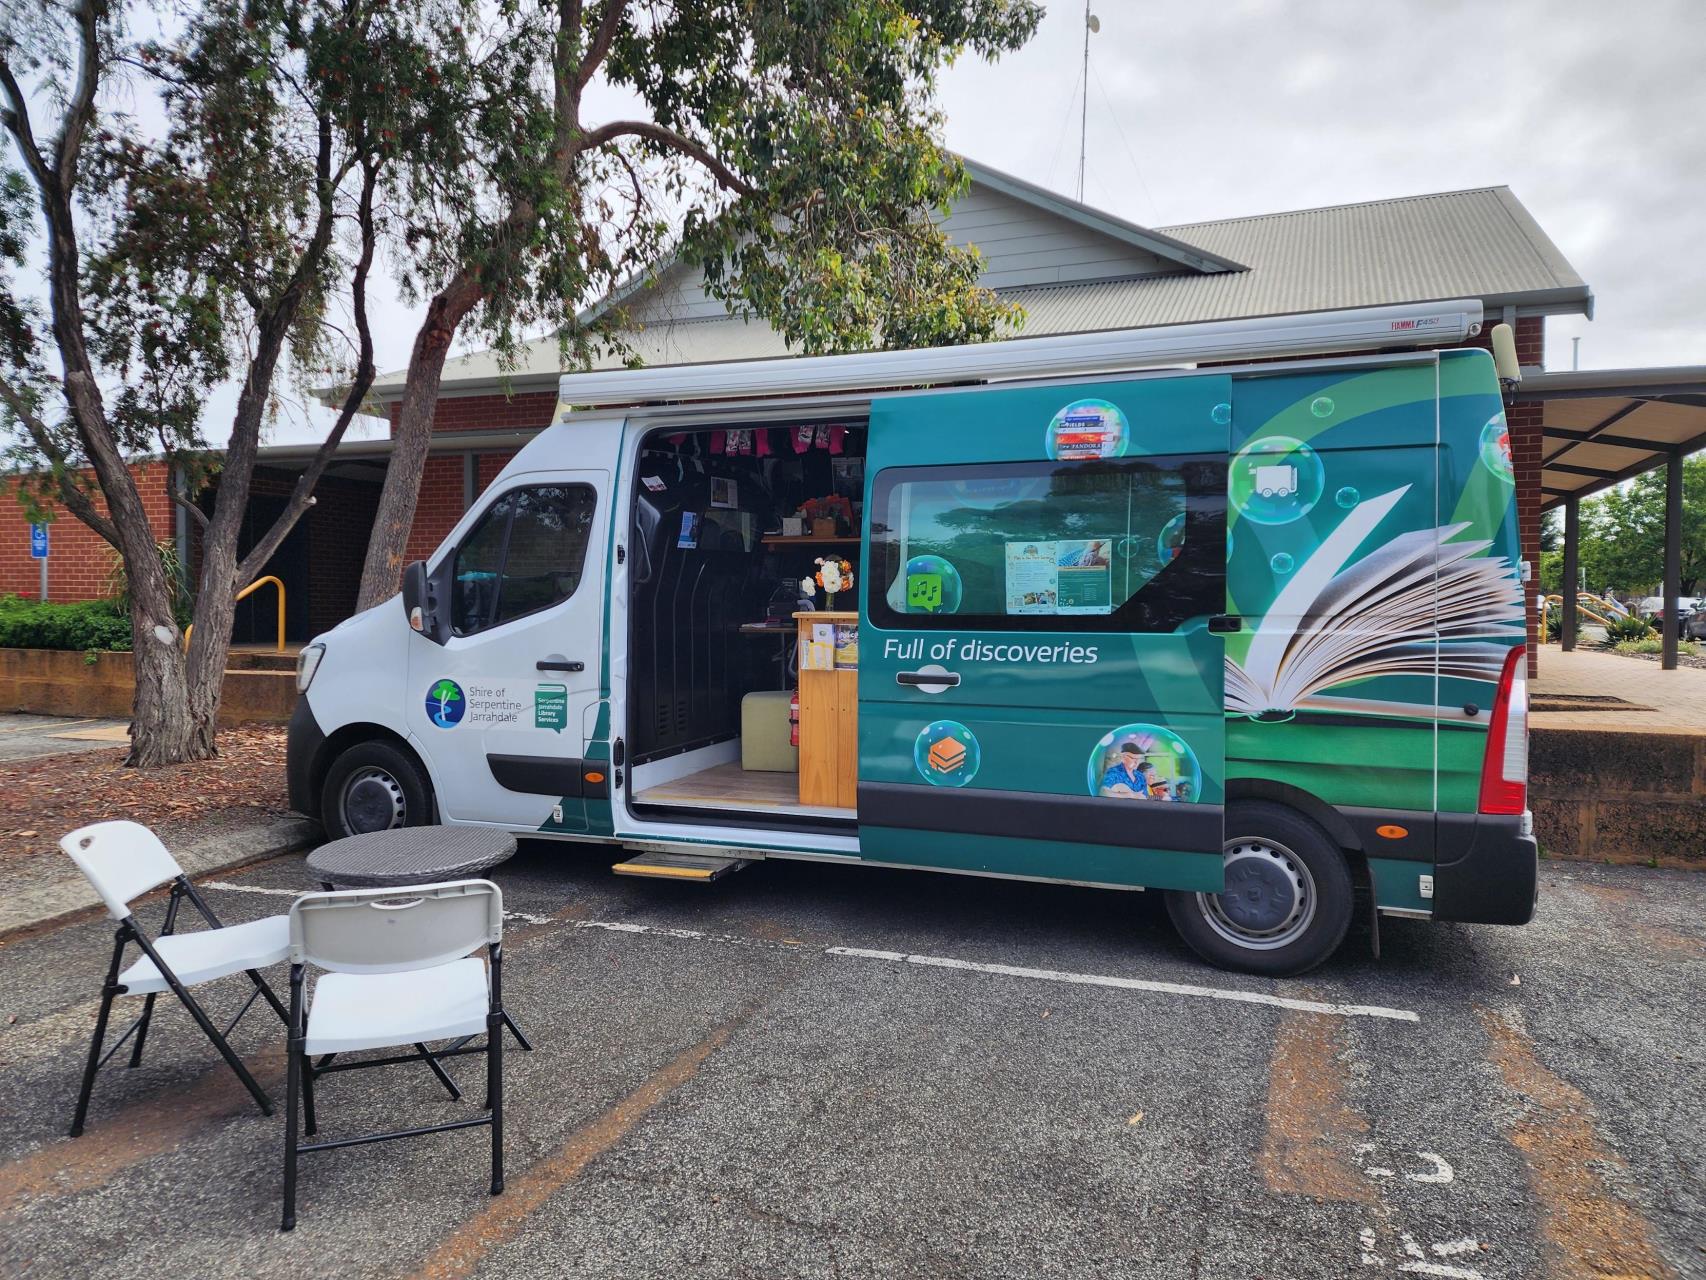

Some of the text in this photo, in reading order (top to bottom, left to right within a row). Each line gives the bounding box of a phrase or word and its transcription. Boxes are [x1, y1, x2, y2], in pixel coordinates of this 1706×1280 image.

[884, 638, 1099, 664] Full of discoveries
[469, 686, 505, 697] Shire of
[469, 698, 522, 712] Serpentine
[468, 711, 518, 723] Jarrahdale
